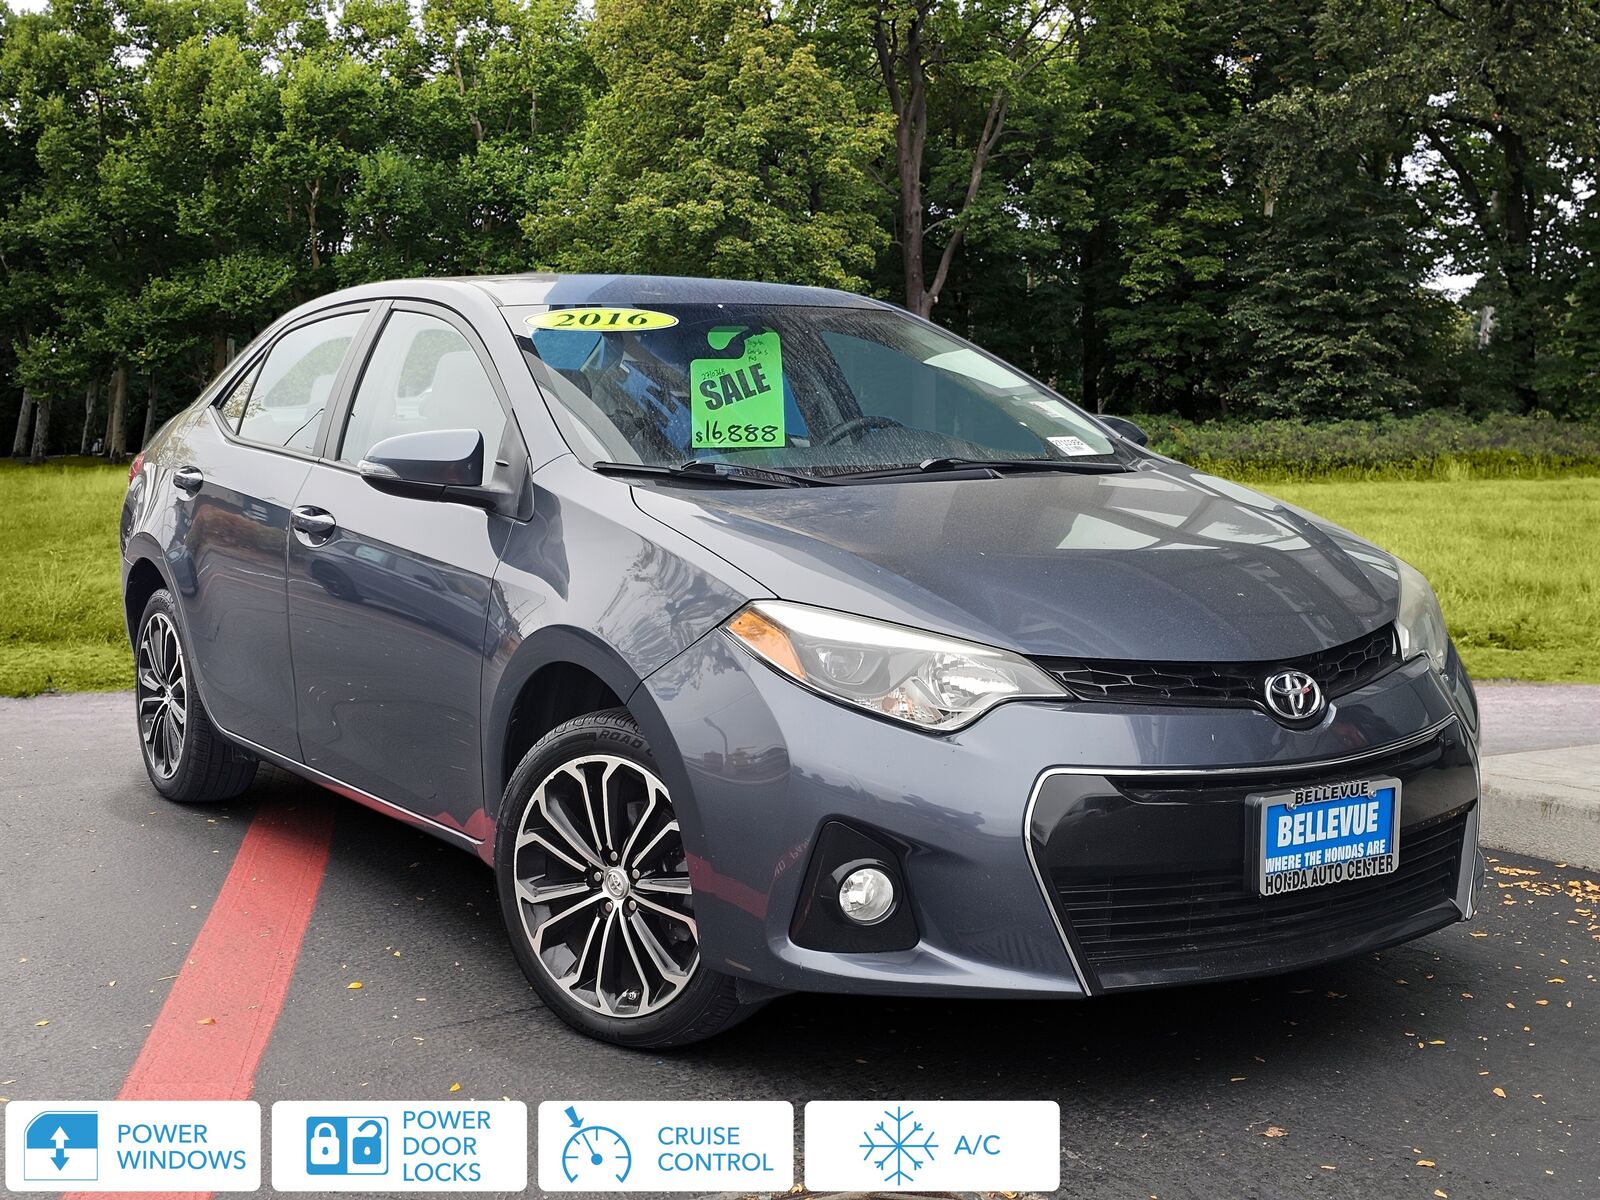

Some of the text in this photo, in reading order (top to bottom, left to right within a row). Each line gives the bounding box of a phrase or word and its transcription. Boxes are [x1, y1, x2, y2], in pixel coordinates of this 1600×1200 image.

[554, 312, 648, 327] 2016
[699, 362, 771, 411] SALE
[695, 420, 778, 444] $16,888
[1295, 782, 1369, 804] BELLEVUE
[1277, 801, 1379, 848] BELLEVUE
[1265, 838, 1386, 873] WHERE THE HONDAS ARE
[1265, 854, 1394, 894] HONDA AUTO CENTER
